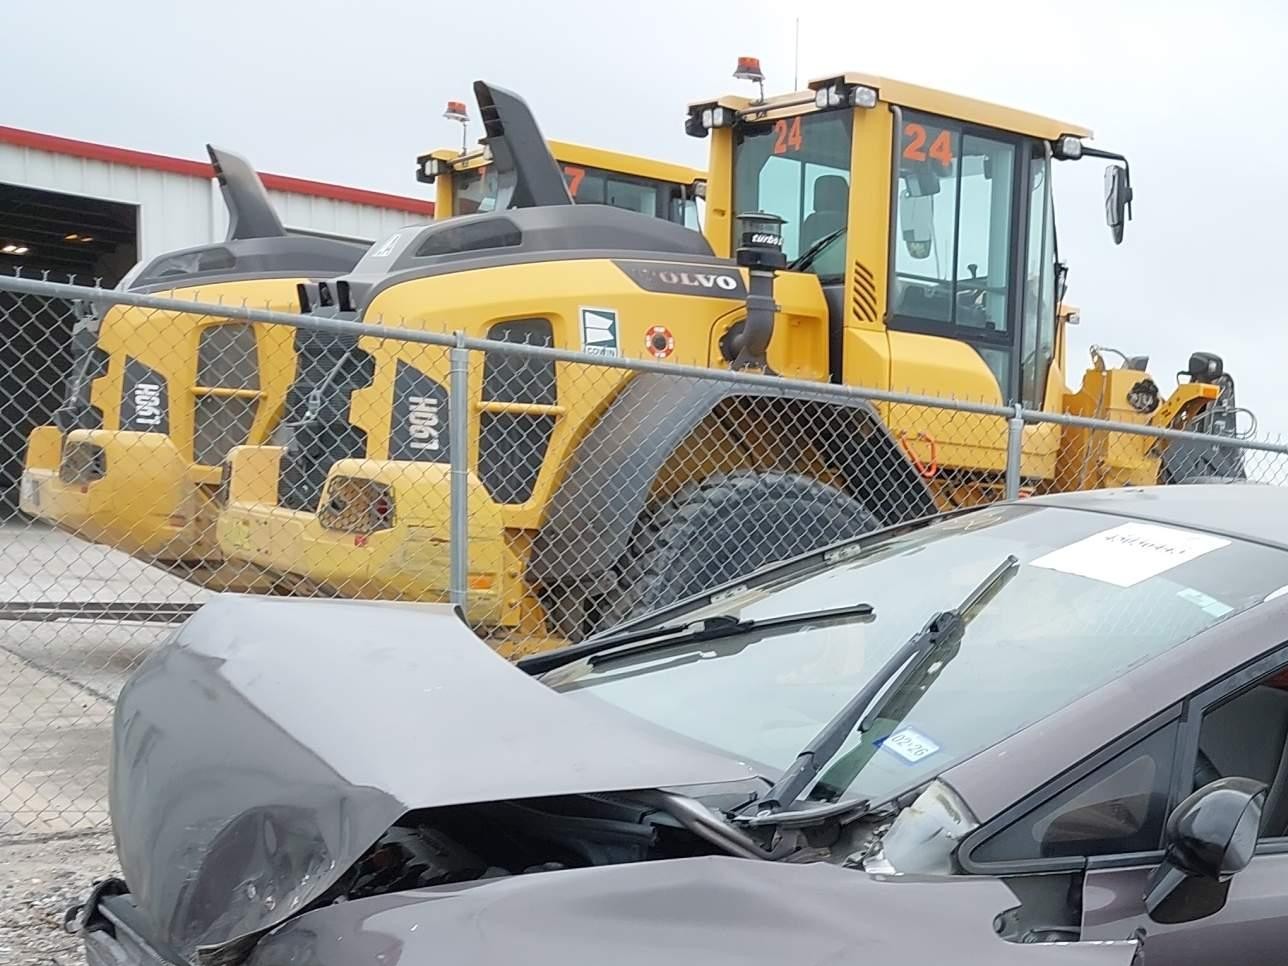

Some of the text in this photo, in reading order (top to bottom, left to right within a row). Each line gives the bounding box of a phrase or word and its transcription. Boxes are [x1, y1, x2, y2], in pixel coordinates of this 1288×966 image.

[773, 116, 803, 155] 24
[903, 123, 953, 167] 24
[640, 270, 738, 290] OLVO
[135, 383, 161, 424] L90H
[408, 396, 440, 450] L90H
